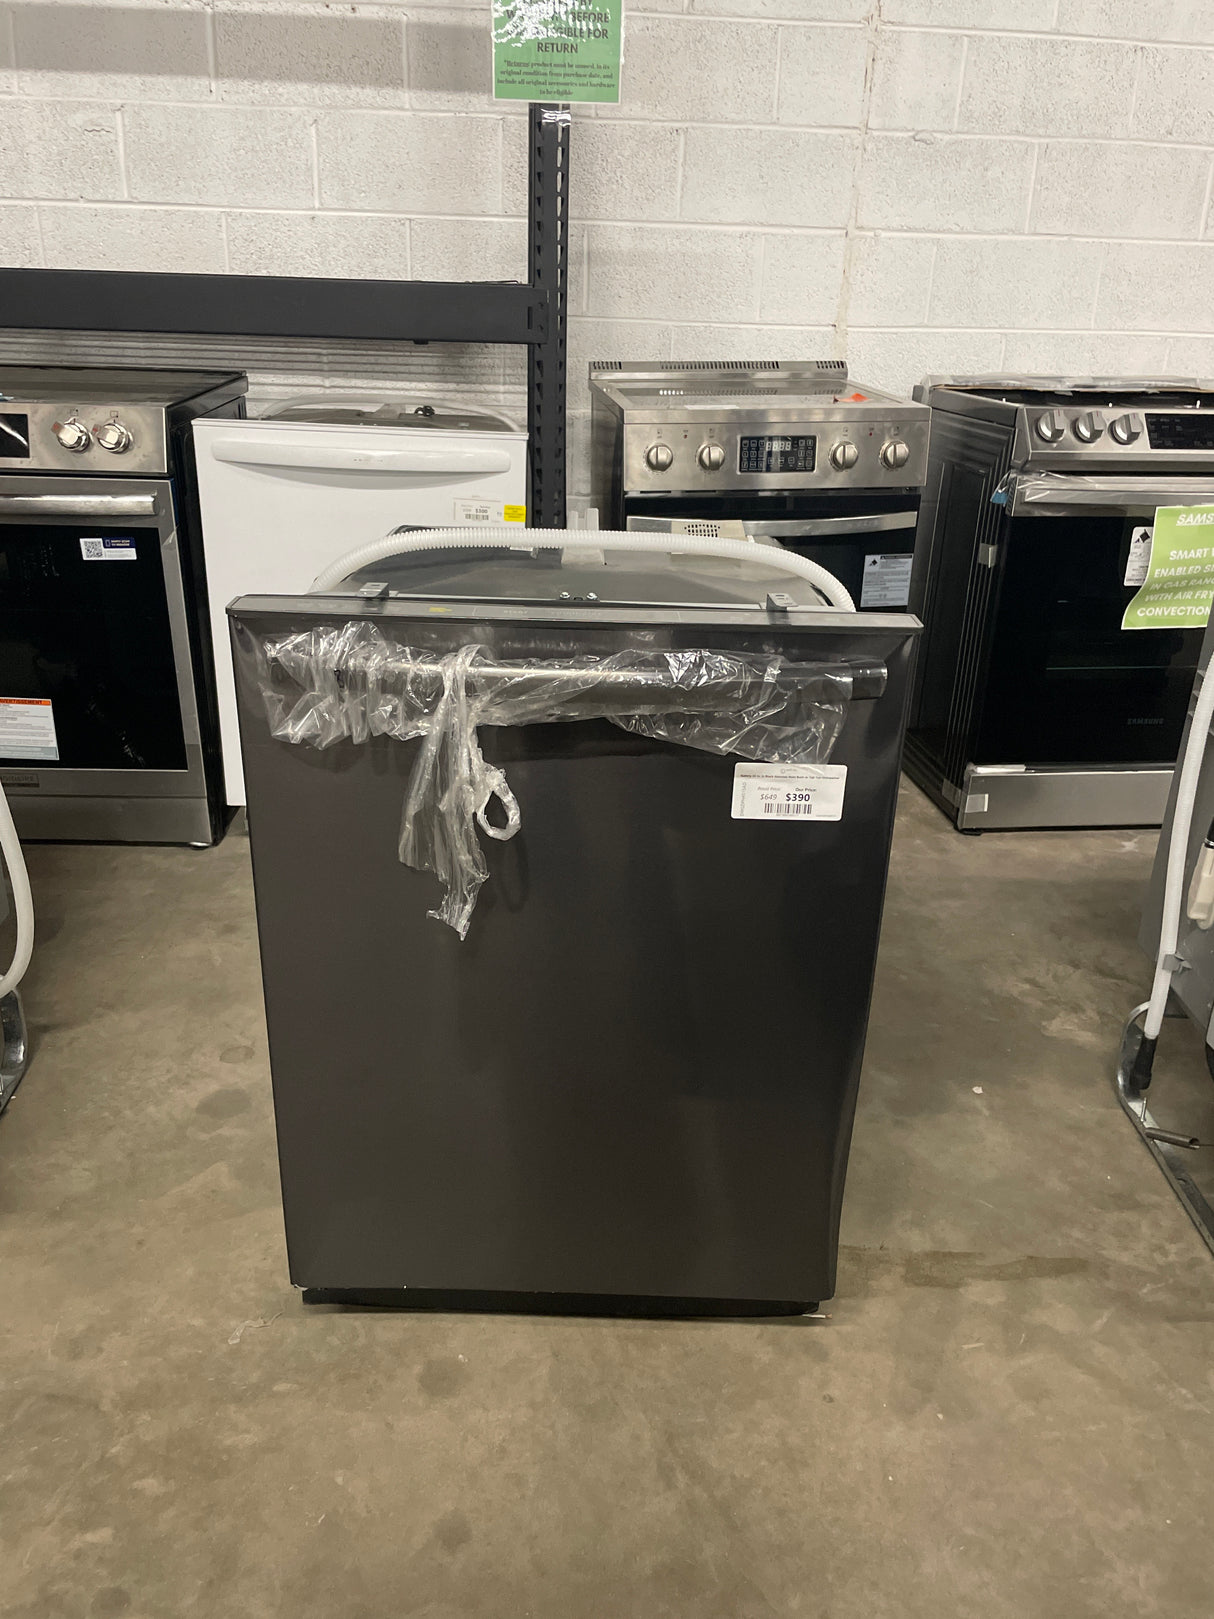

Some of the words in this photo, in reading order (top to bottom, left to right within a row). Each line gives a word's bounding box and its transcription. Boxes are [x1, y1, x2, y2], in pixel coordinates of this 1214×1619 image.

[571, 11, 609, 23] BEFORE
[588, 28, 609, 39] FOR
[537, 42, 578, 53] RETURN
[1169, 547, 1209, 560] SMART
[1154, 565, 1201, 578] ENABLED
[1149, 583, 1161, 591] IN
[1163, 580, 1188, 589] GAS
[1145, 592, 1173, 602] WITH
[1174, 591, 1193, 600] AIR
[760, 793, 777, 801] $649
[785, 793, 811, 802] $390
